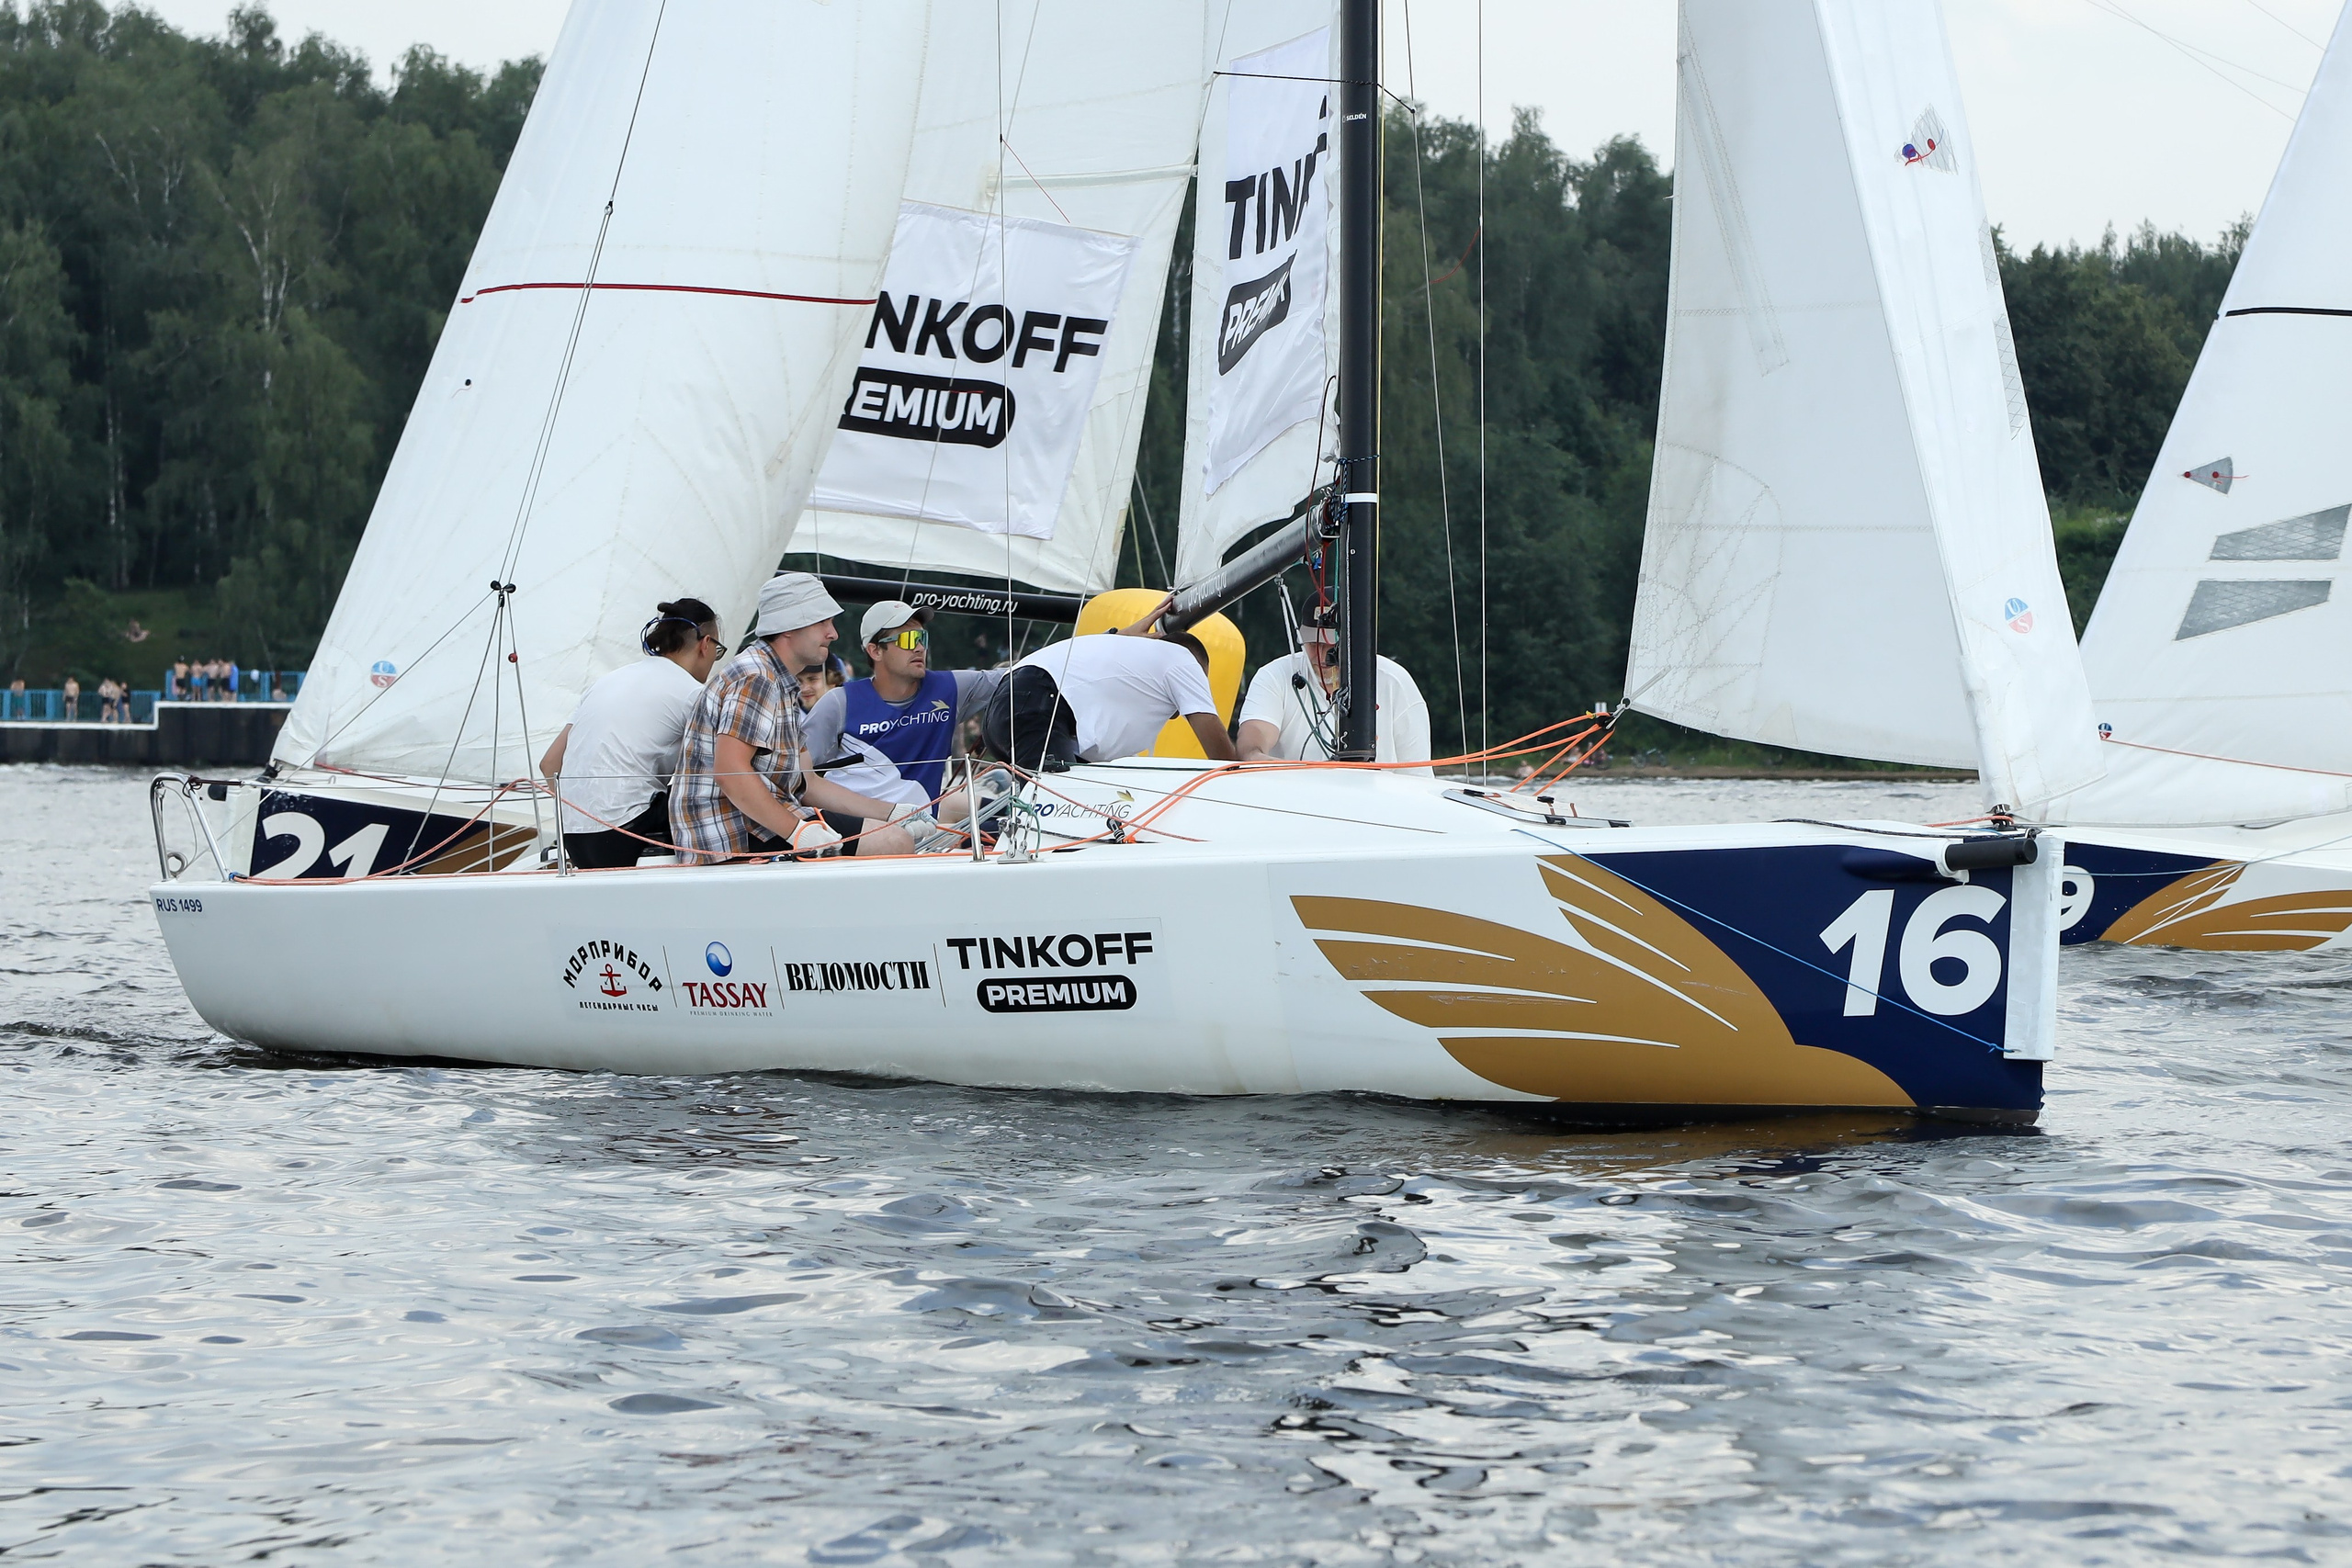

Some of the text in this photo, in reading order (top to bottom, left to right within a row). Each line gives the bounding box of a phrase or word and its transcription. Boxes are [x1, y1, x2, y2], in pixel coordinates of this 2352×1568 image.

[865, 291, 1108, 372] NKOFF
[849, 380, 1002, 434] EMIUM
[910, 592, 1019, 615] pro-yachting.ru
[252, 812, 390, 877] 21
[156, 898, 203, 912] RUS 1499
[563, 940, 662, 992] МОРПРИБОР
[946, 932, 1153, 970] TINKOFF
[1819, 886, 2007, 1017] 16
[683, 983, 767, 1008] TASSAY
[785, 961, 931, 995] ВЕДОМОСТИ
[986, 981, 1127, 1007] PREMIUM
[580, 1001, 659, 1011] ЛЕГЕНДАРНЫЕ ЧАСЫ
